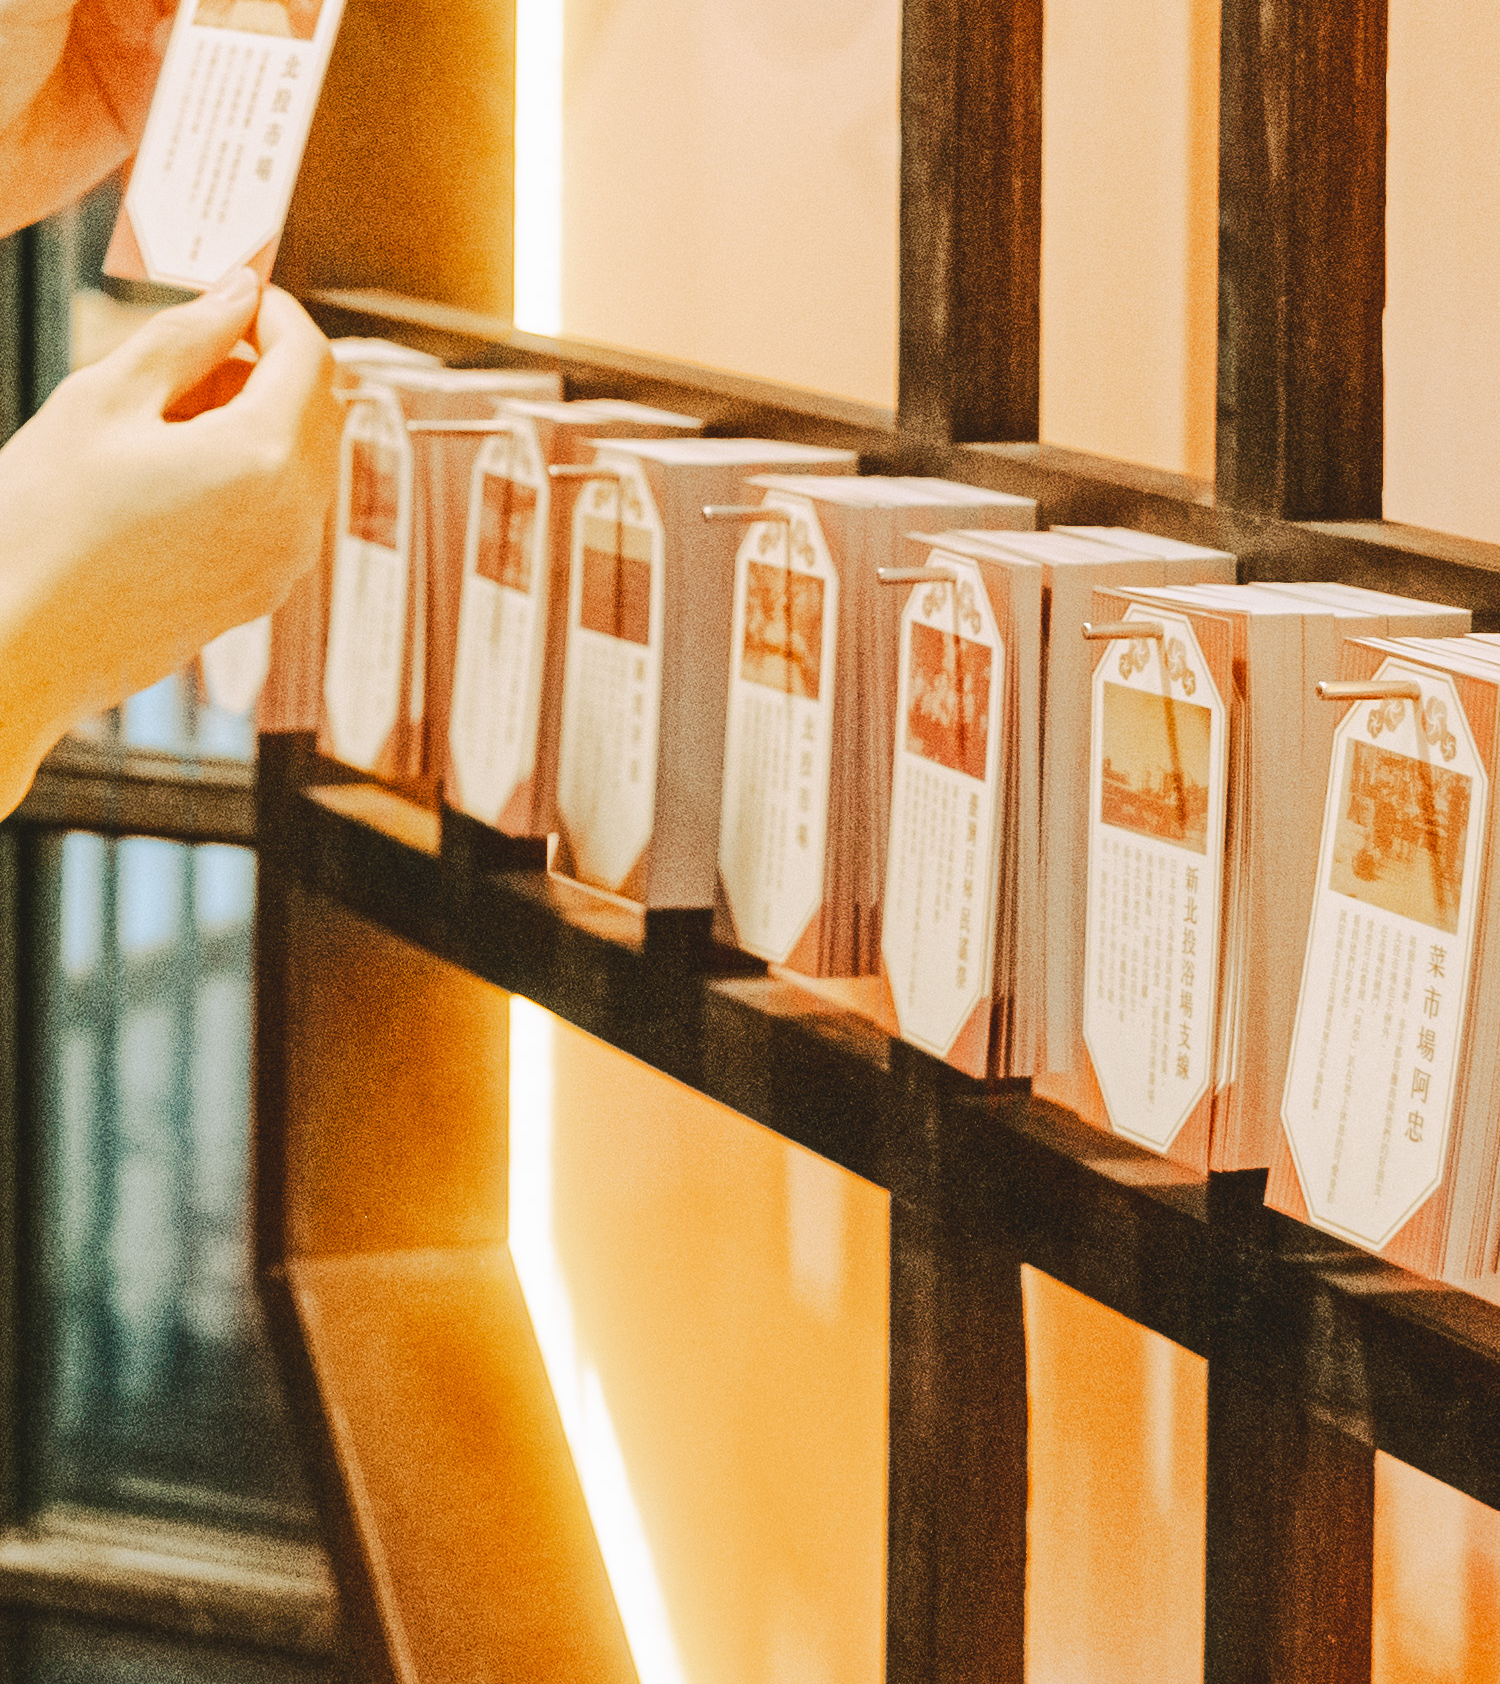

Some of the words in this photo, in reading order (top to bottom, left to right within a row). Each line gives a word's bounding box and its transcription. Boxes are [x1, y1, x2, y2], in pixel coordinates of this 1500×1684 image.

[1404, 943, 1447, 1144] 菜市場阿忠
